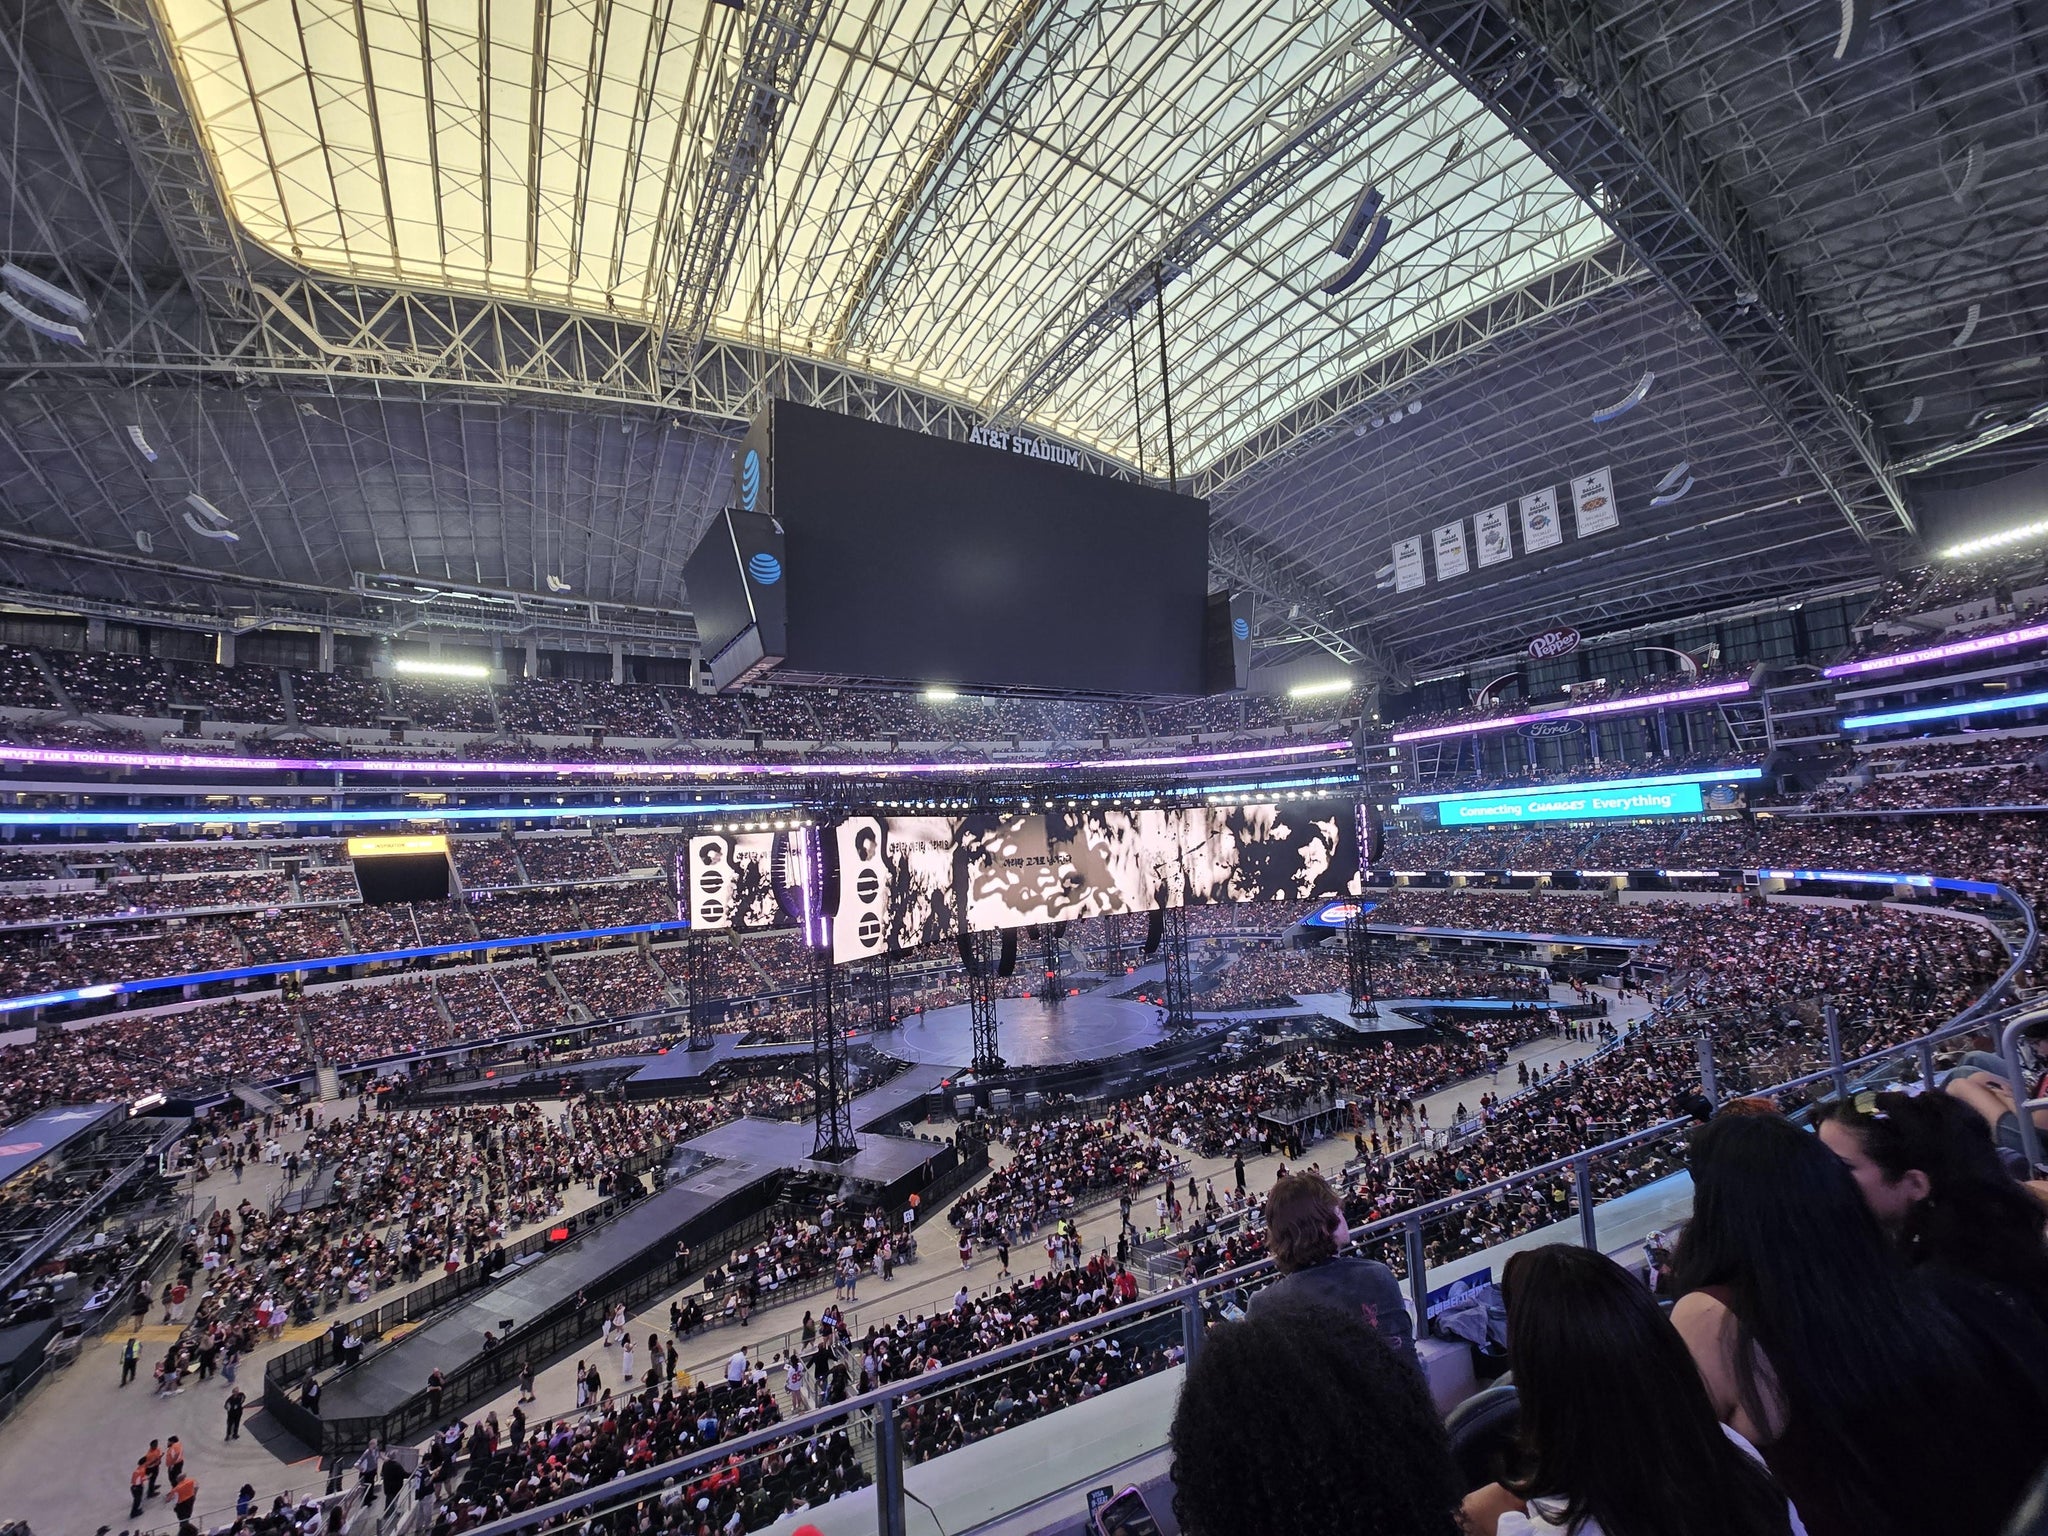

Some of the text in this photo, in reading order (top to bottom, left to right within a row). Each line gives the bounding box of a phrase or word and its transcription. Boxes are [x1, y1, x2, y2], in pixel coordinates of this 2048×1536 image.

[968, 425, 1079, 467] AT&T STADIUM
[1532, 632, 1576, 658] Pepper
[1543, 631, 1562, 644] Dr
[1530, 721, 1570, 736] Ford
[44, 751, 70, 761] LIKE
[73, 753, 105, 762] YOUR
[109, 755, 144, 764] ICONS
[147, 757, 175, 765] WITH
[195, 757, 278, 768] Blockchain.com
[1459, 794, 1672, 818] Connecting CHANGES Everything
[1003, 856, 1025, 868] 아리랑
[1026, 856, 1046, 866] 고개로
